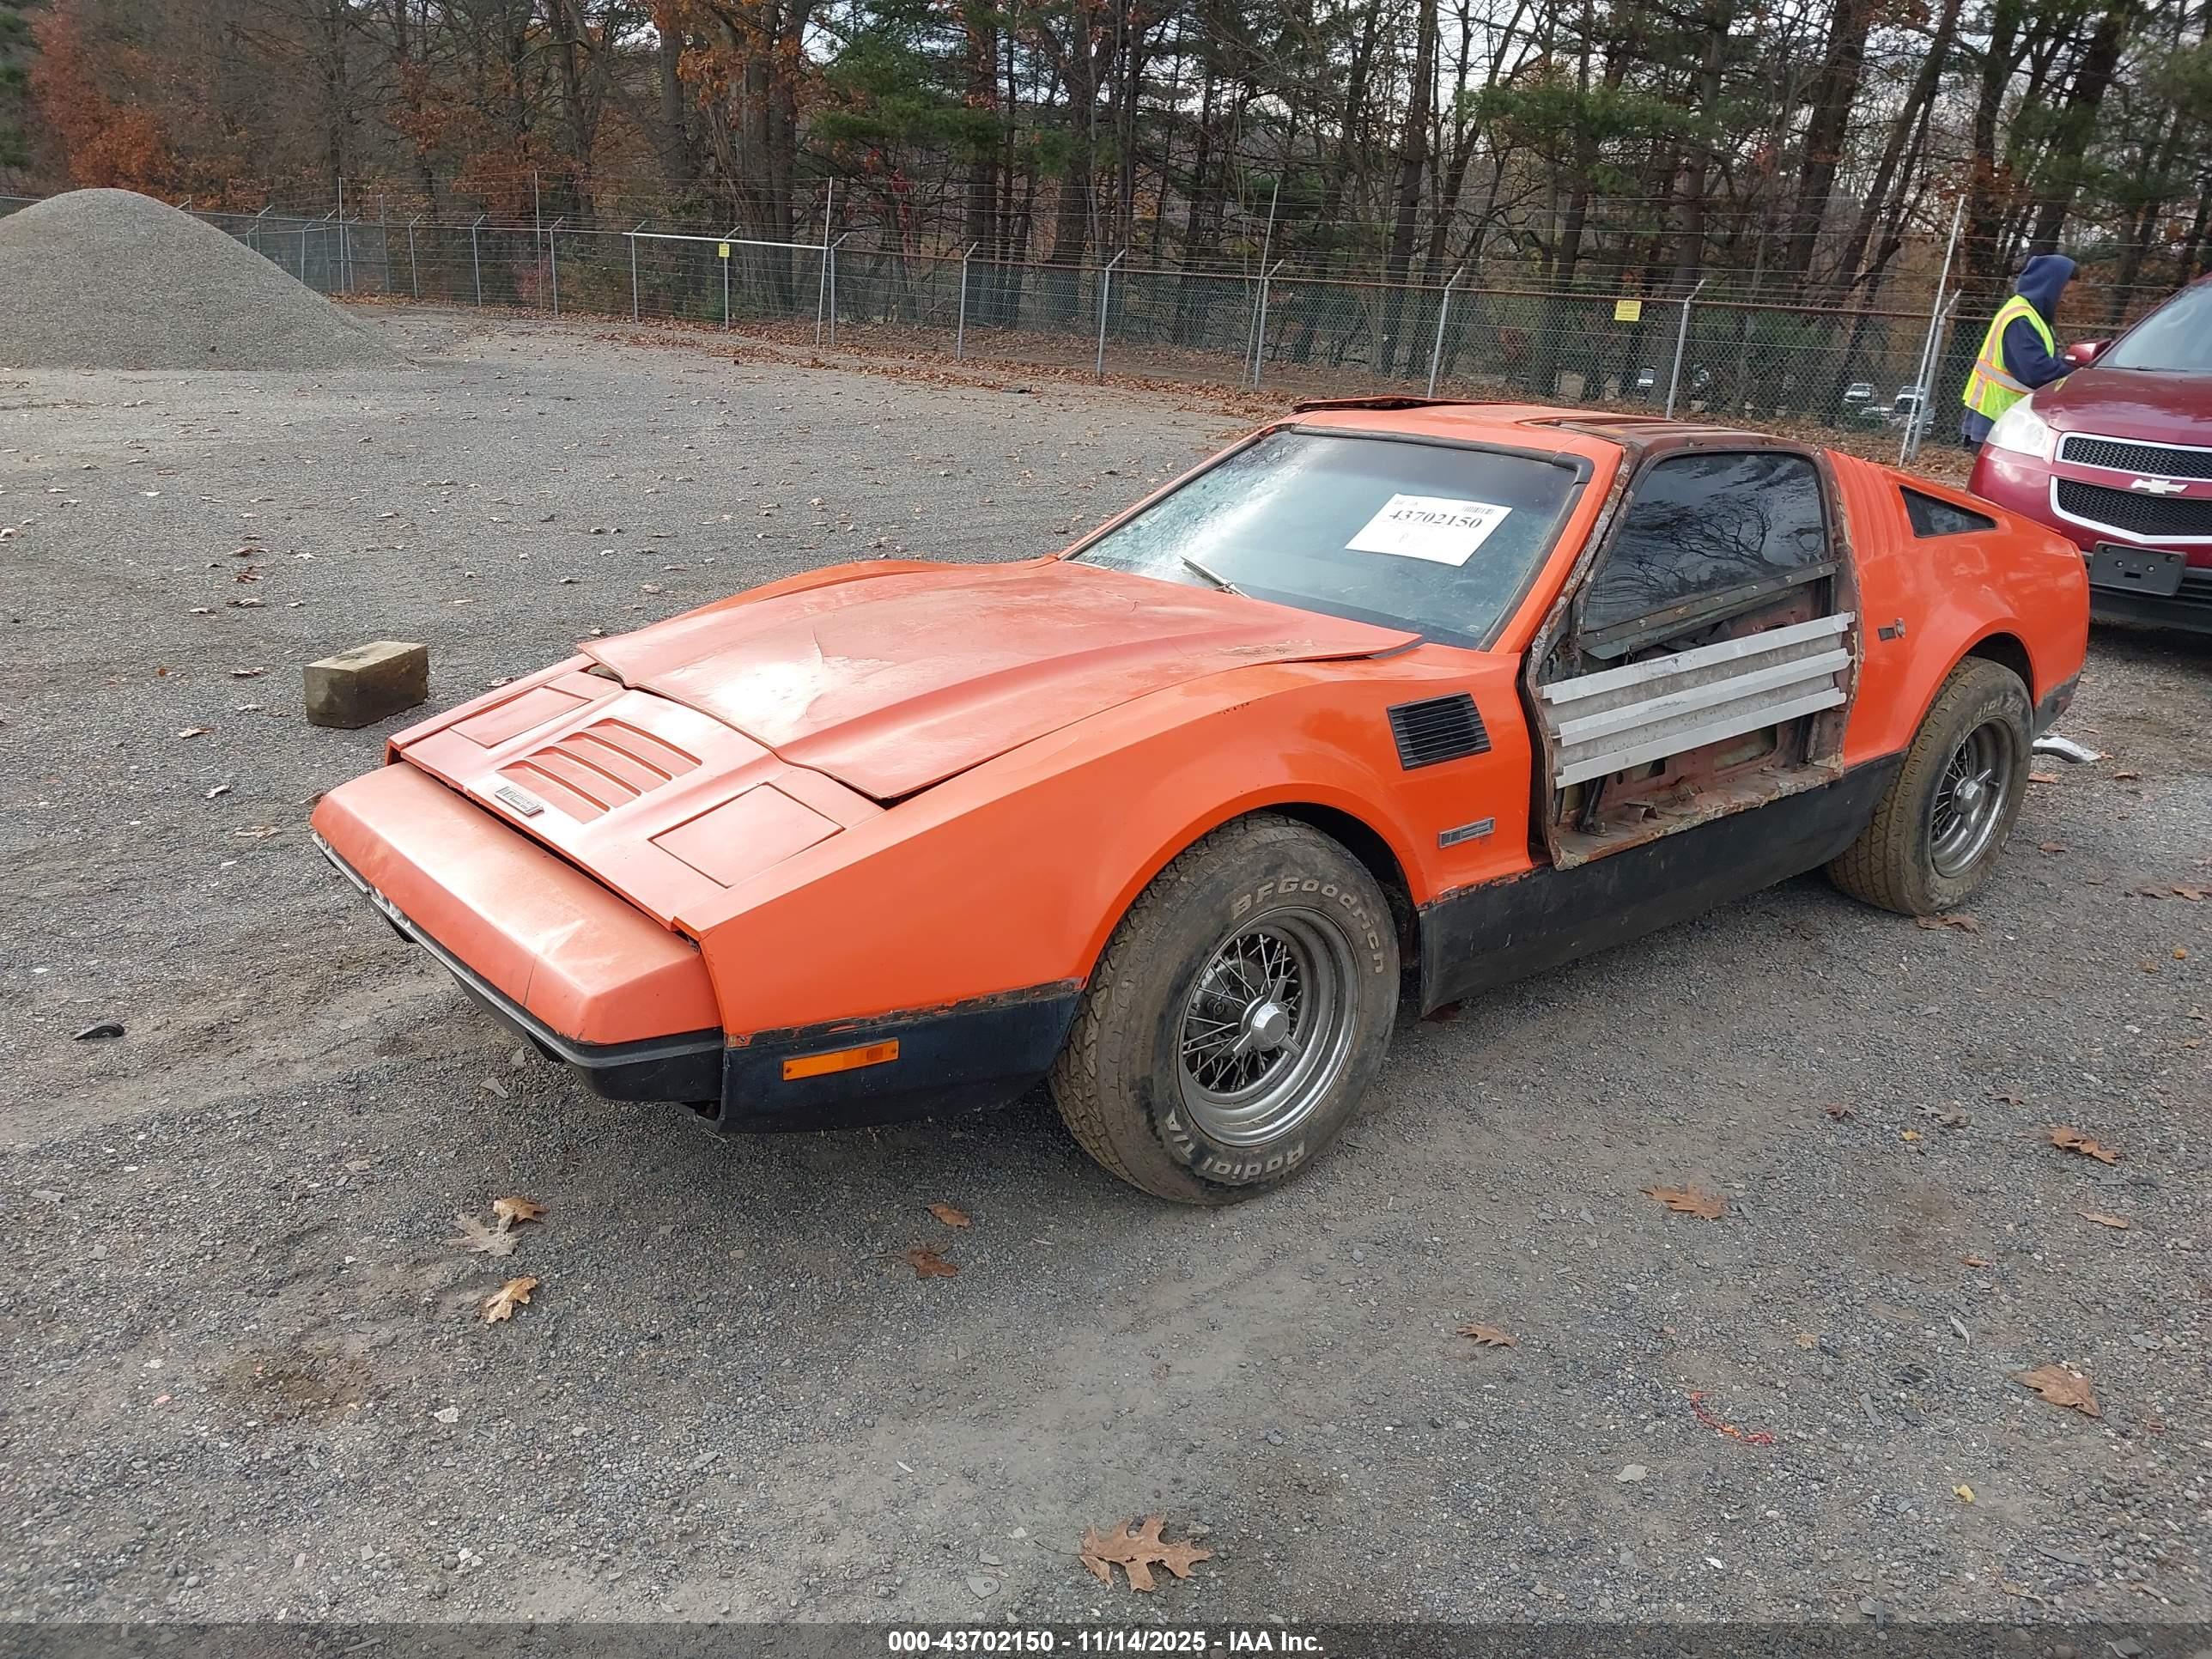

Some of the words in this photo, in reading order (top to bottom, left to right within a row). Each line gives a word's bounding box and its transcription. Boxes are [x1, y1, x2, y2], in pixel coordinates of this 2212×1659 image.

[1389, 510, 1483, 529] 43702150
[1231, 877, 1384, 974] BFGoodrich
[1165, 1109, 1195, 1160] T/A
[1201, 1141, 1305, 1181] Radial
